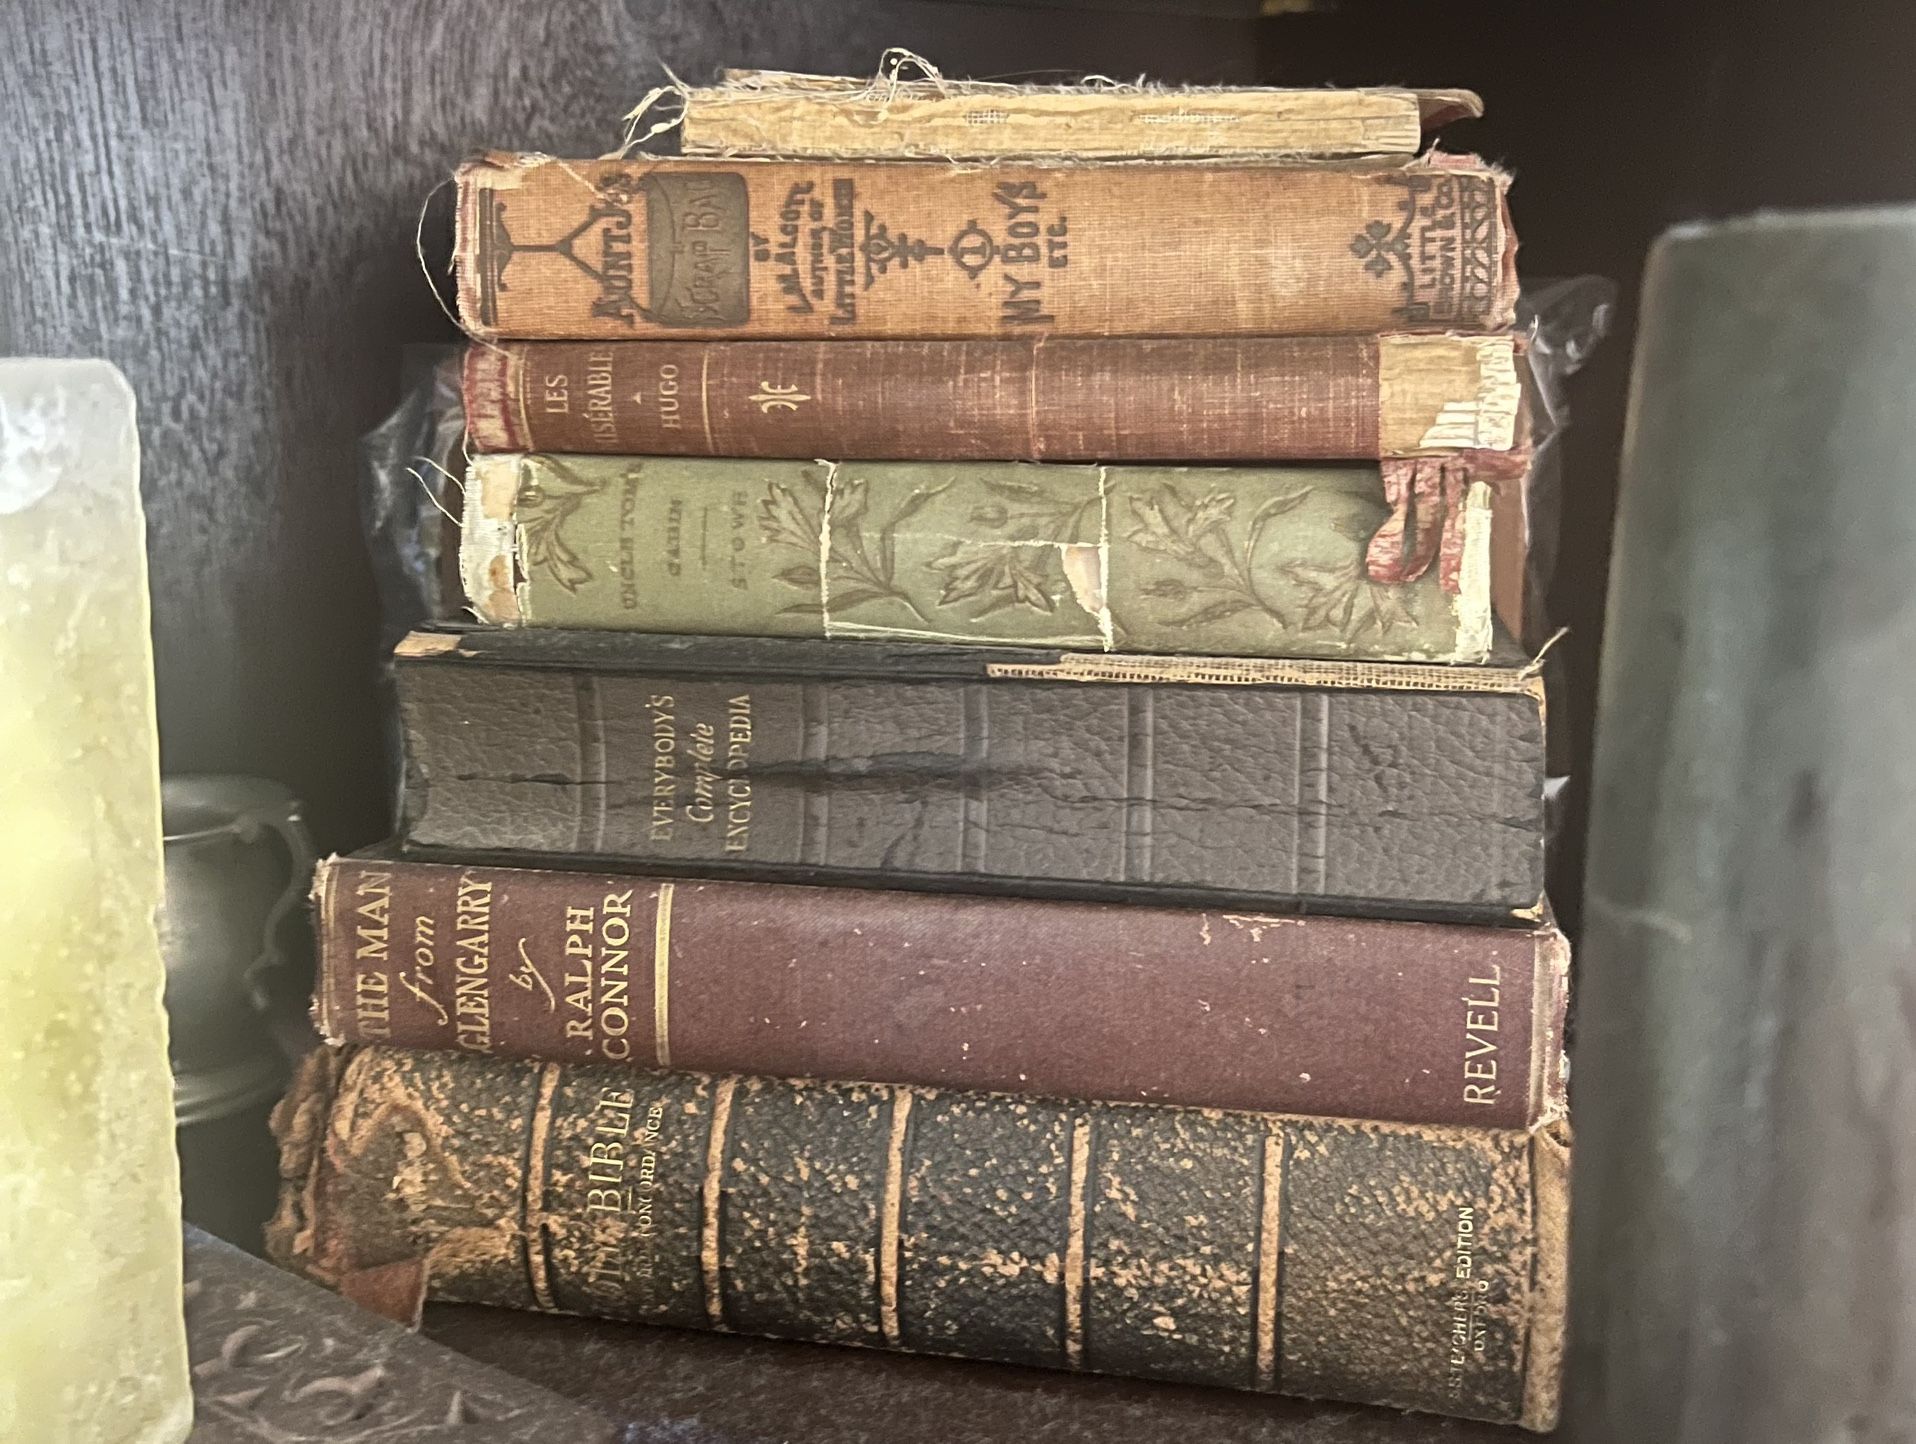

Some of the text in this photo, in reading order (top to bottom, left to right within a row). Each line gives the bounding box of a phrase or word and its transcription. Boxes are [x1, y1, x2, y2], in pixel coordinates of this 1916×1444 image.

[1048, 216, 1068, 268] ETC.
[1420, 206, 1435, 289] LITTLE
[999, 274, 1054, 325] MY
[545, 374, 569, 413] LES
[659, 363, 682, 429] HUGO
[620, 537, 638, 610] UNCLE
[667, 498, 681, 577] CABIN
[730, 490, 748, 590] STOWE
[645, 694, 676, 841] EVERYBODY'S
[356, 870, 392, 1038] THE MAN
[399, 916, 448, 1025] from
[456, 870, 492, 1053] GLENGARRY
[509, 938, 556, 1013] by
[565, 906, 594, 1040] RALPH
[601, 890, 633, 1059] CONNOR
[1463, 964, 1501, 1105] REVELL
[586, 1086, 634, 1213] BIBLE
[1456, 1206, 1474, 1279] EDITION
